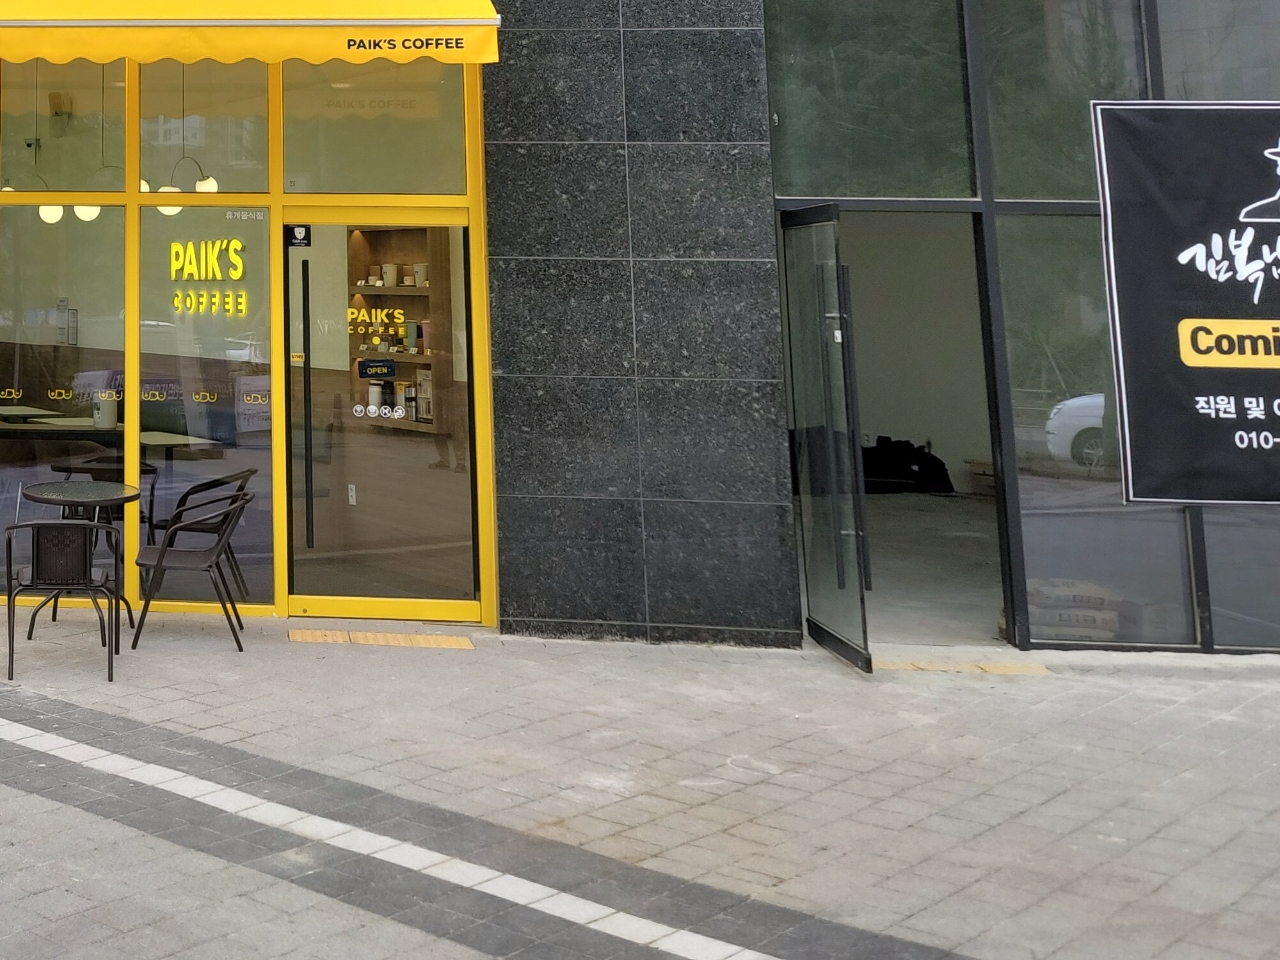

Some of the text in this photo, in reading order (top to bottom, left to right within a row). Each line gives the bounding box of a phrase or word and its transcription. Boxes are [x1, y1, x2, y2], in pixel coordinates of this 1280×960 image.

[347, 37, 465, 50] PAIK'S COFFEE
[170, 238, 245, 281] PAIK'S
[172, 291, 247, 315] COFFEE
[347, 308, 406, 324] PAIK'S
[347, 326, 406, 335] COFFEE
[366, 366, 388, 375] OPEN
[1195, 395, 1237, 419] 직원
[1243, 397, 1267, 420] 및
